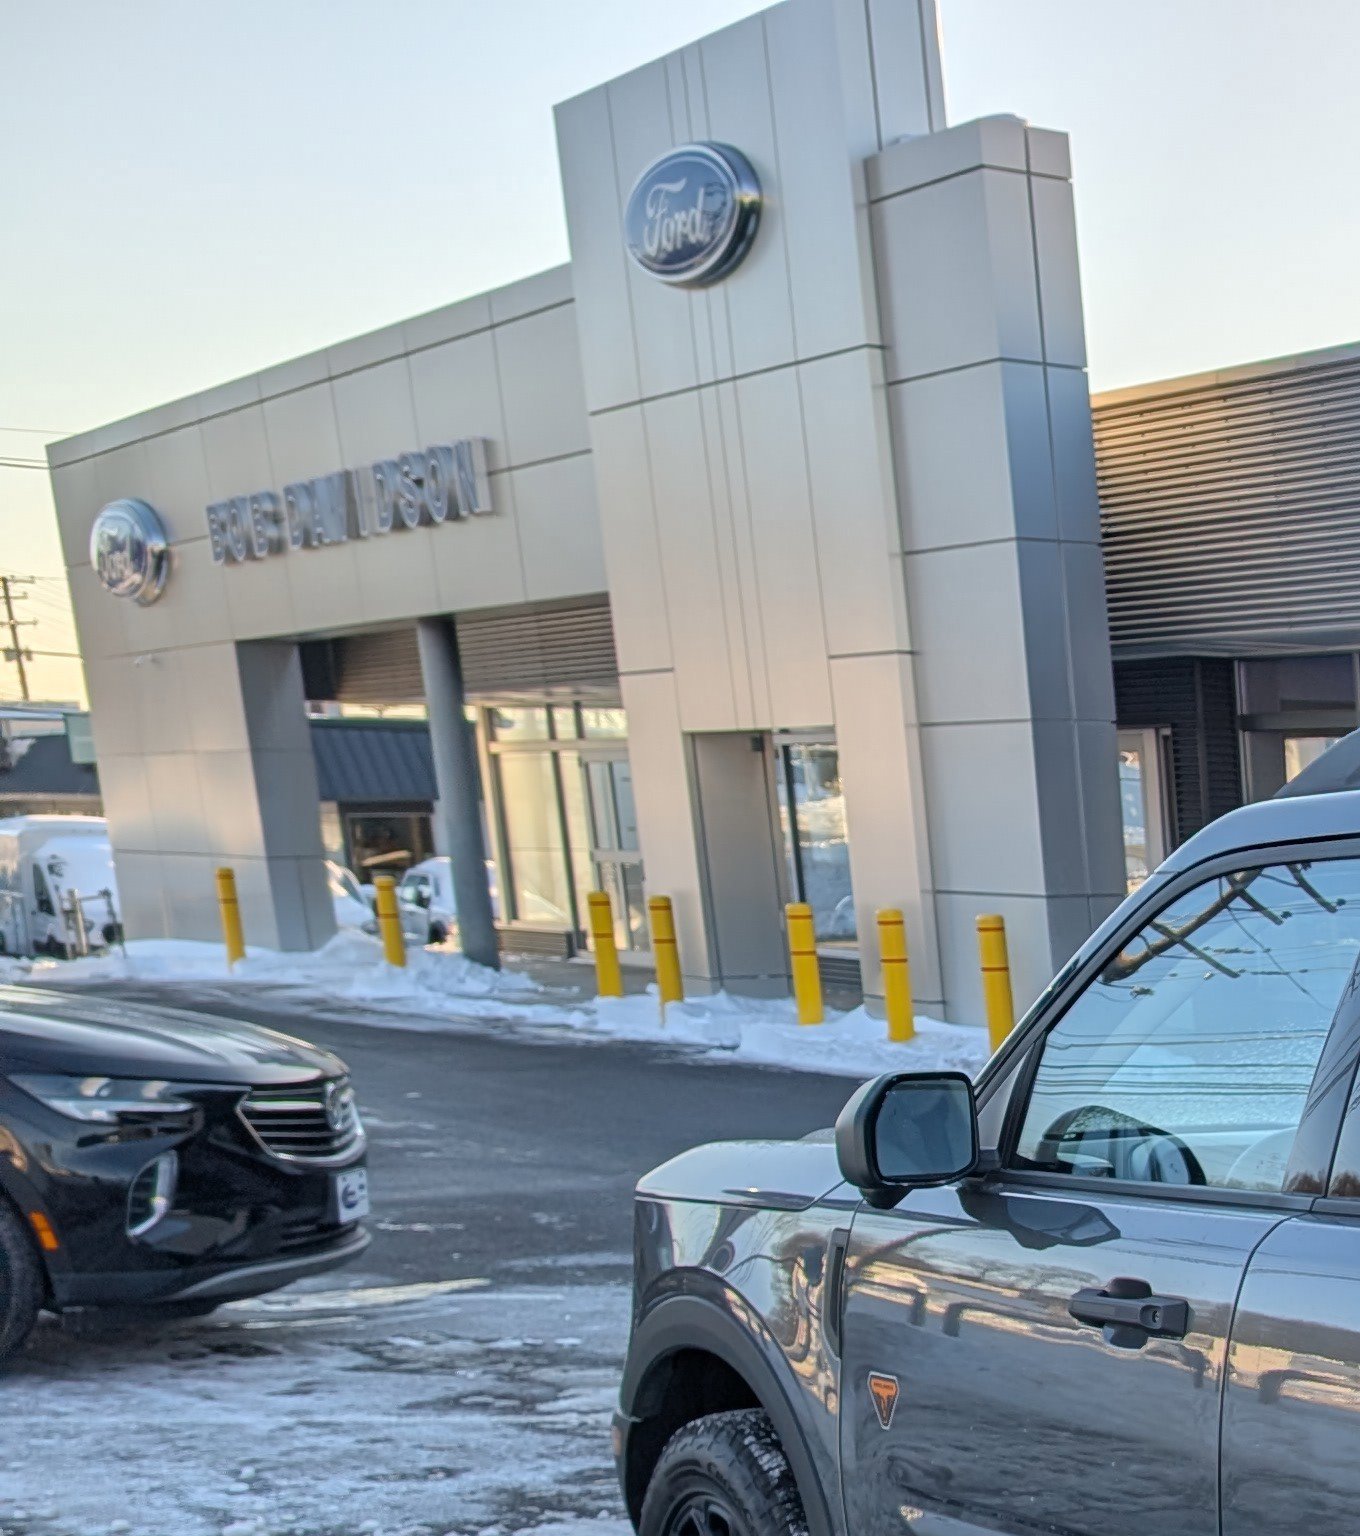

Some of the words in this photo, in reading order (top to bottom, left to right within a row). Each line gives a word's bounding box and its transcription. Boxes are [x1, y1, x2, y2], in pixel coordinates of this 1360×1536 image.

[643, 178, 711, 257] Ford
[206, 491, 284, 566] BOB
[284, 437, 494, 550] DAVIDSON
